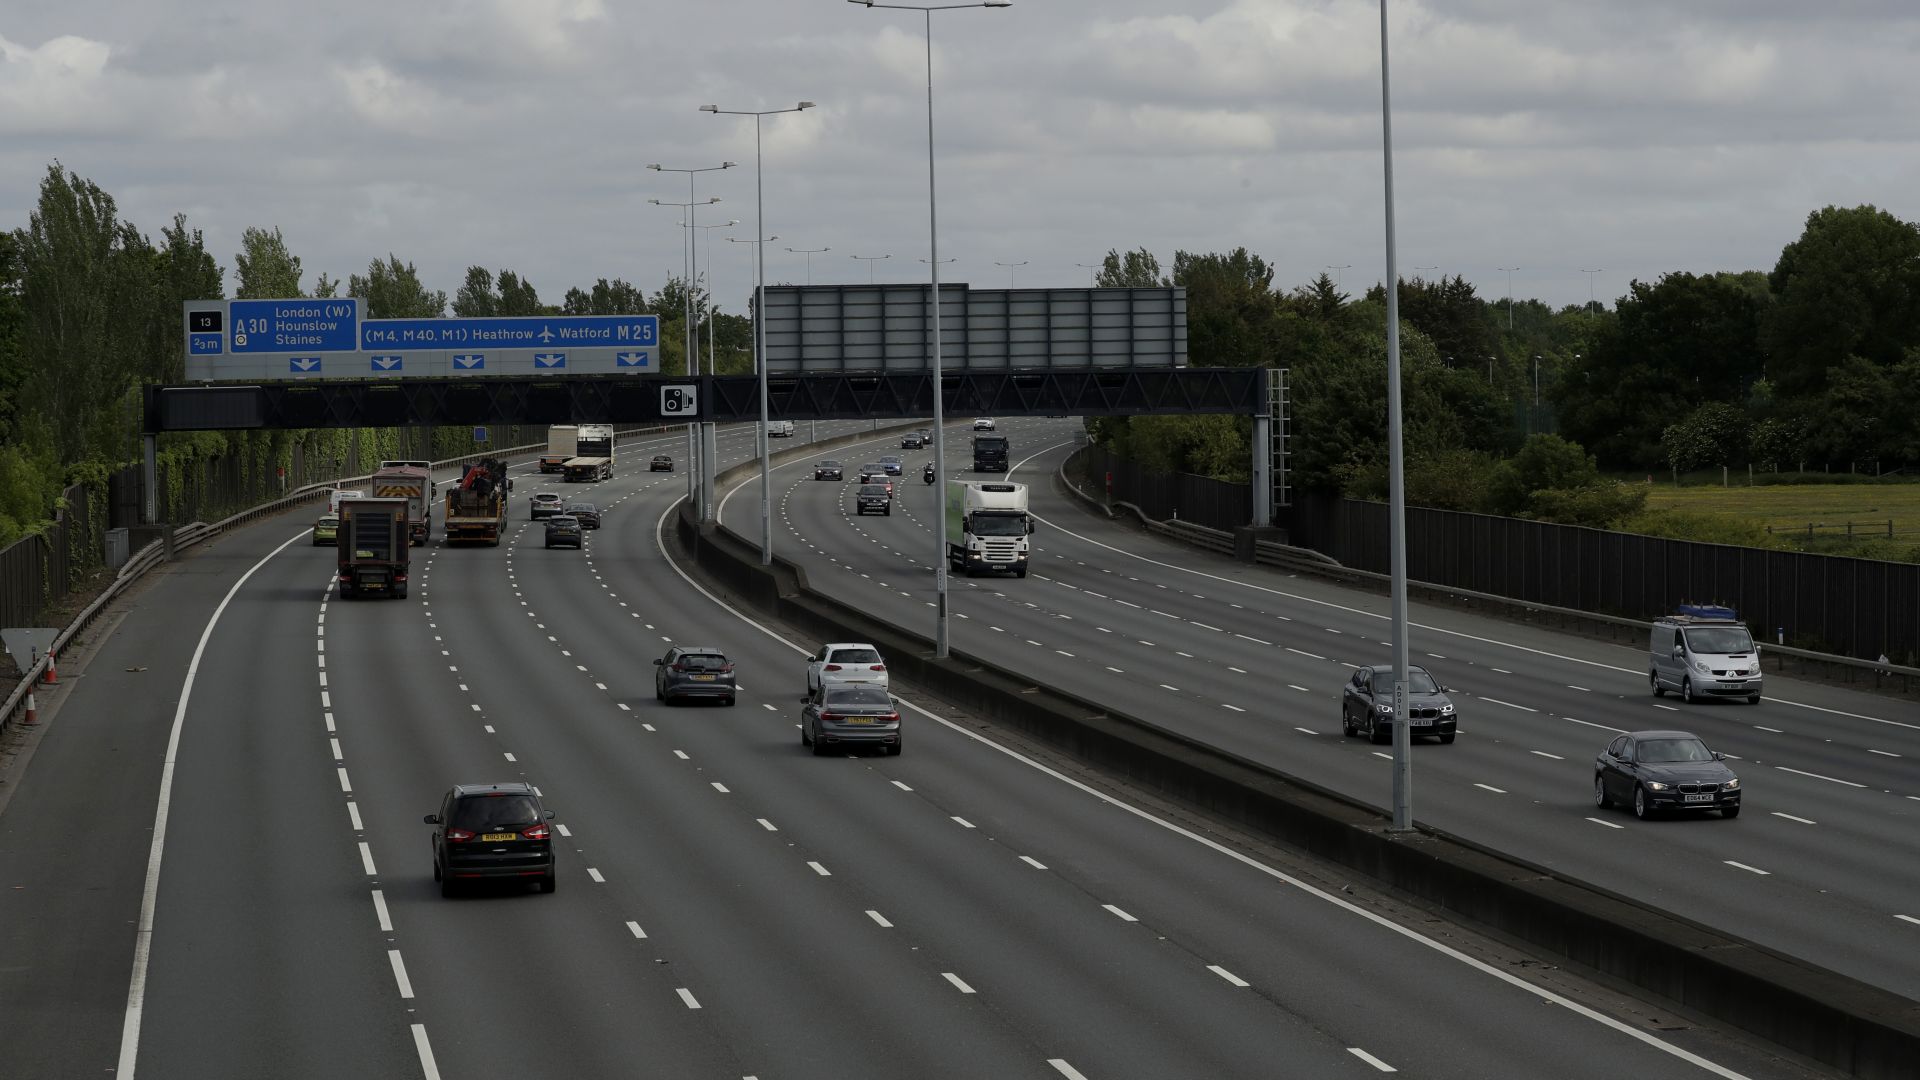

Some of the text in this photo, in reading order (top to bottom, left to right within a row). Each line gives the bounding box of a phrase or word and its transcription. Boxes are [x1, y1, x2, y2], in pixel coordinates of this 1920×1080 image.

[275, 304, 352, 319] London (W)
[200, 317, 212, 327] 13
[275, 320, 337, 332] Hounslow
[275, 334, 322, 345] Staines
[472, 327, 534, 340] Heathrow
[559, 327, 611, 339] Watford
